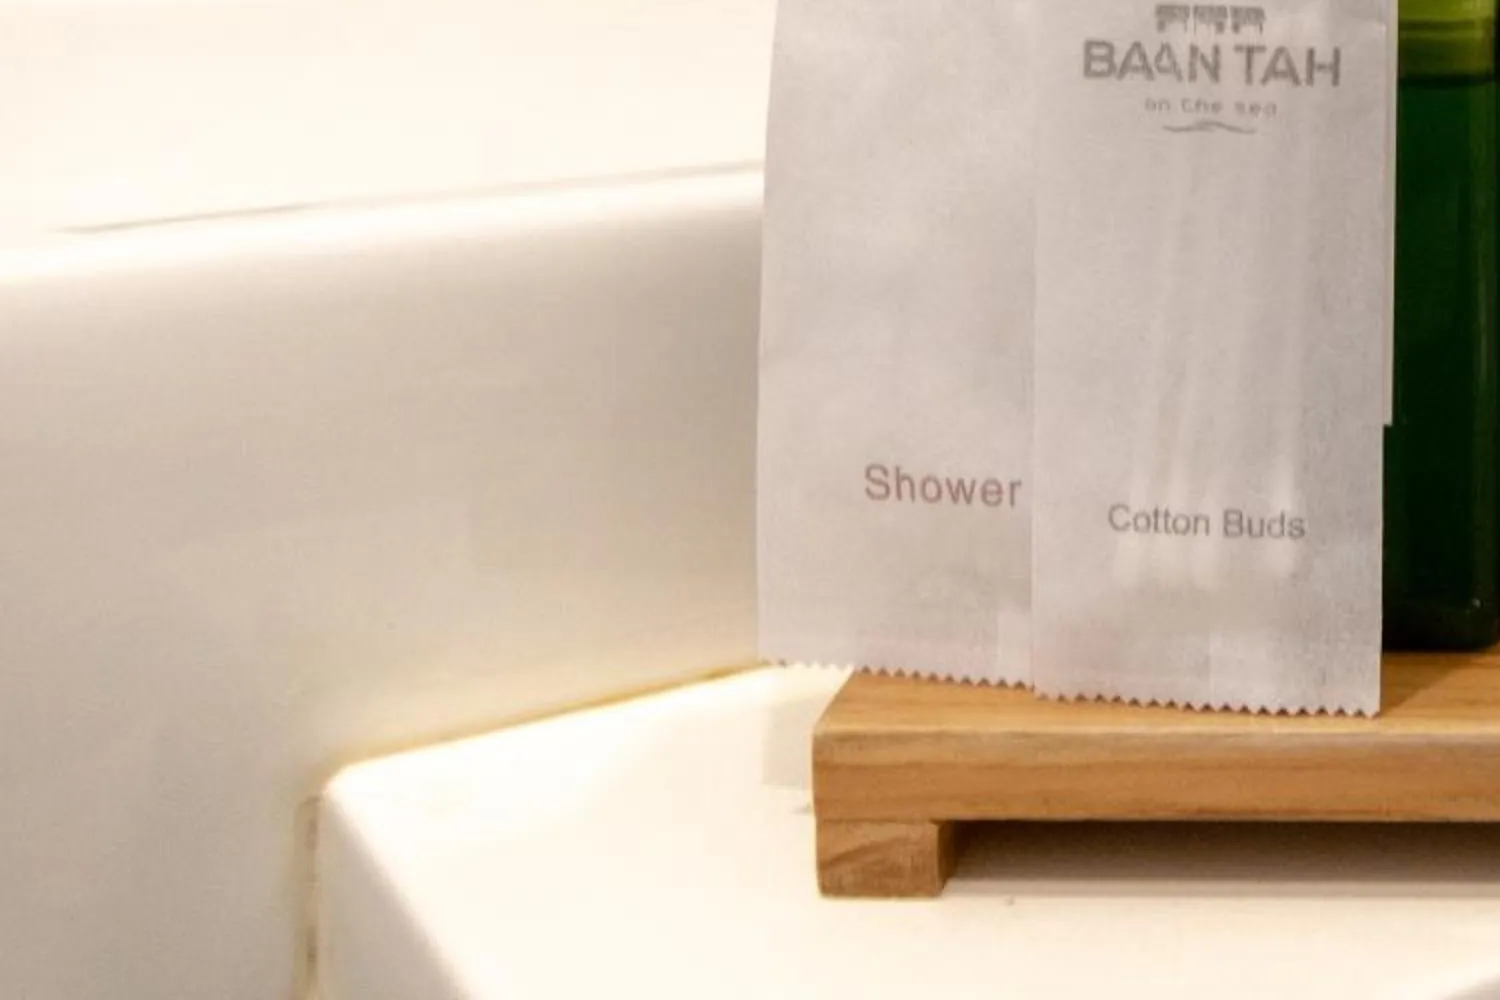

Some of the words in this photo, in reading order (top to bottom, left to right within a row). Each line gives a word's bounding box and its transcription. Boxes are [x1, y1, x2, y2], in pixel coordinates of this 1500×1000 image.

[1083, 39, 1221, 83] BAAN
[1233, 44, 1341, 88] TAH
[864, 464, 1022, 509] Shower
[1107, 504, 1210, 537] Cotton
[1222, 509, 1307, 541] Buds
